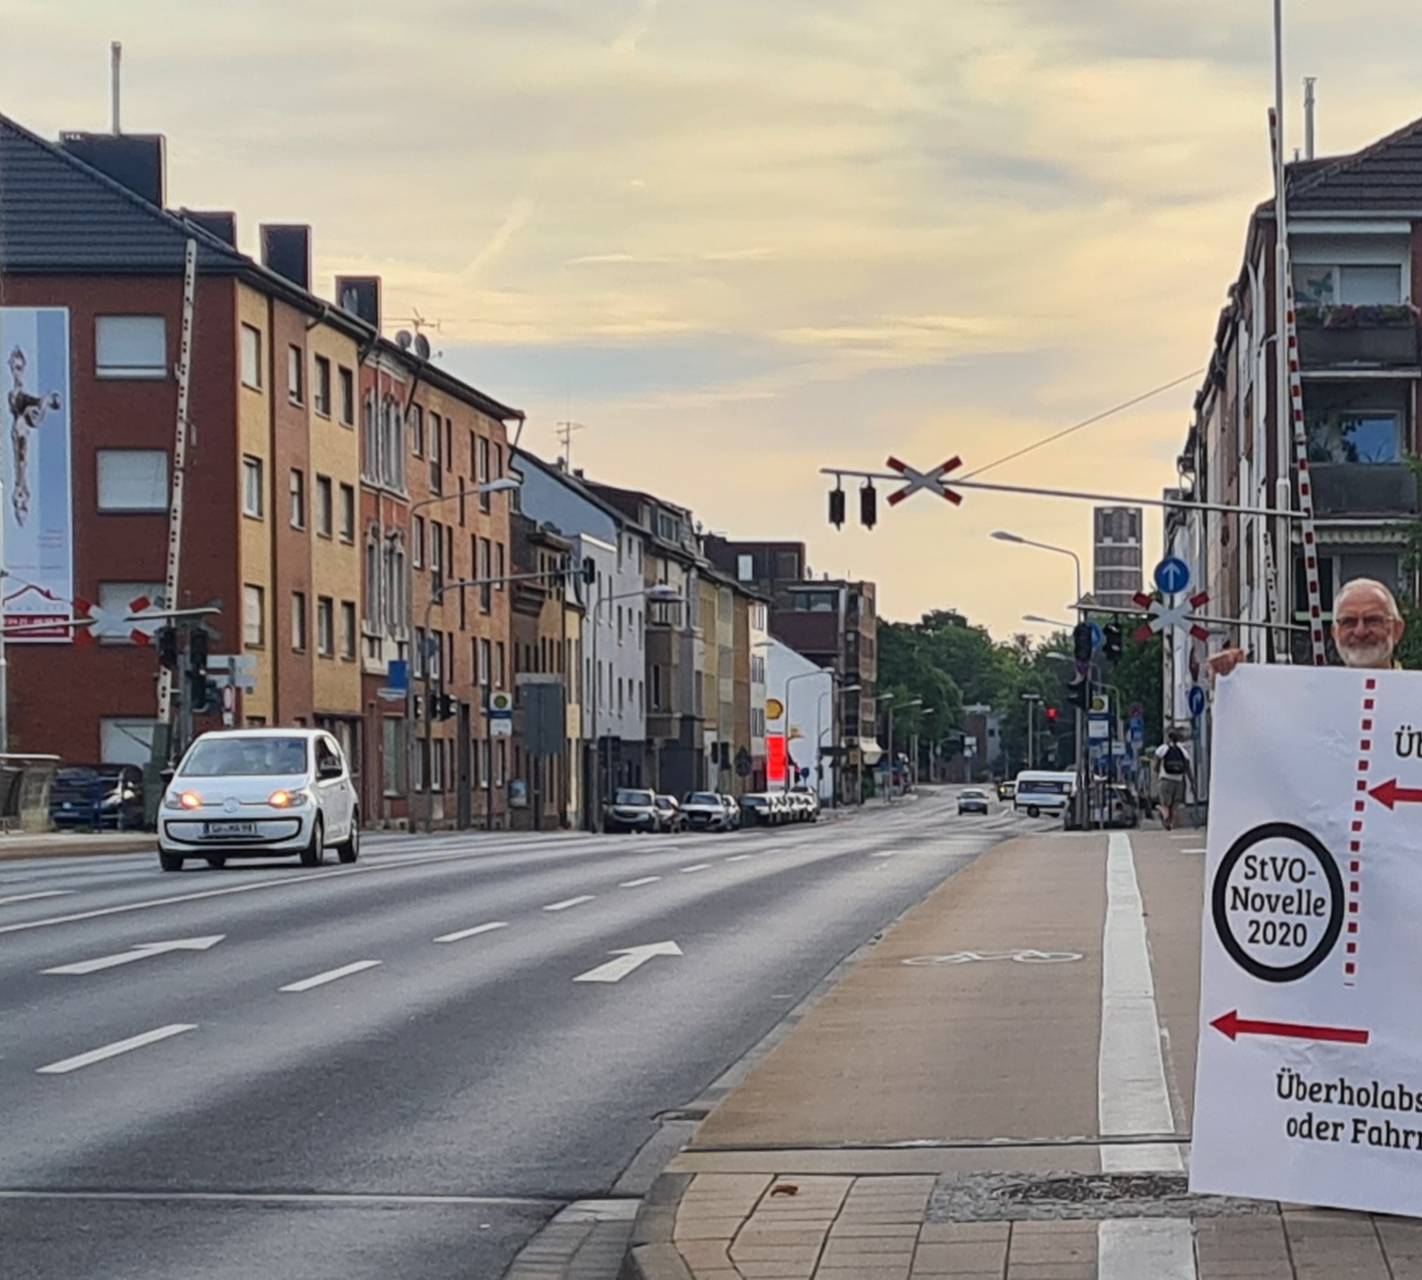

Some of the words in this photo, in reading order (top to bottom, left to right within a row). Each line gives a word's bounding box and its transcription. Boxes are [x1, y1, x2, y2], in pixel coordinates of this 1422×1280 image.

[1244, 854, 1316, 884] StVO-
[1230, 885, 1326, 918] Novelle
[1247, 919, 1308, 948] 2020
[1286, 1113, 1345, 1142] oder
